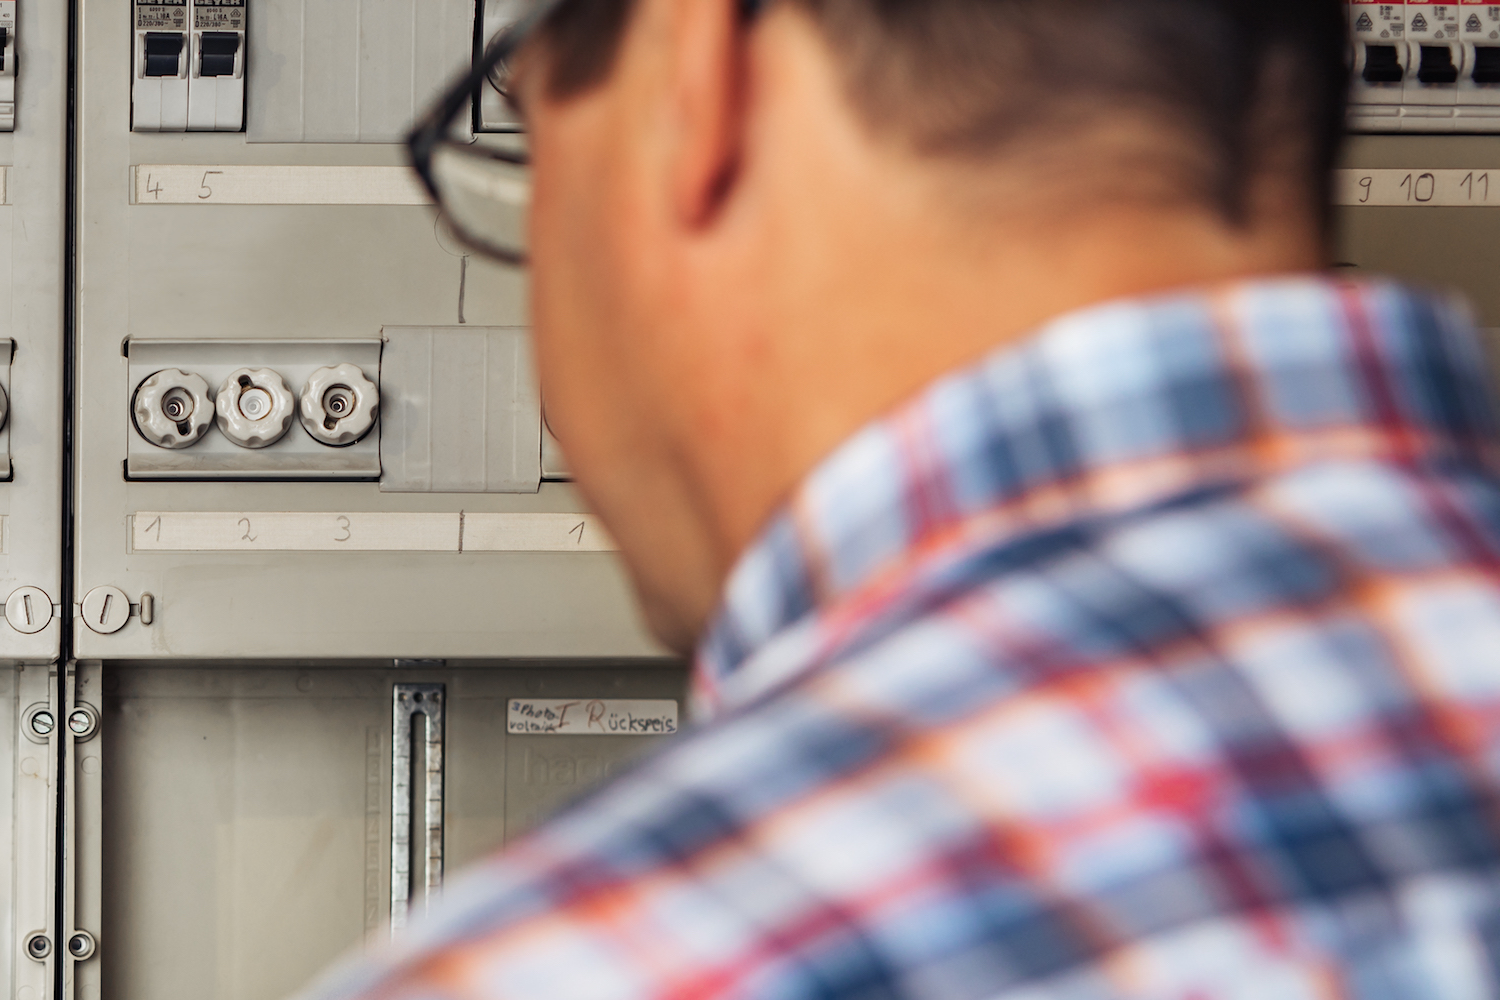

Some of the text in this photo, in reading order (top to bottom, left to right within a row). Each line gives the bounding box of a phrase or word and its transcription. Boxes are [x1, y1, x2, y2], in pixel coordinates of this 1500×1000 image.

[147, 171, 223, 200] 4 5
[1359, 173, 1488, 203] 9 10 11
[145, 515, 351, 542] 1 2 3
[569, 521, 585, 544] 1
